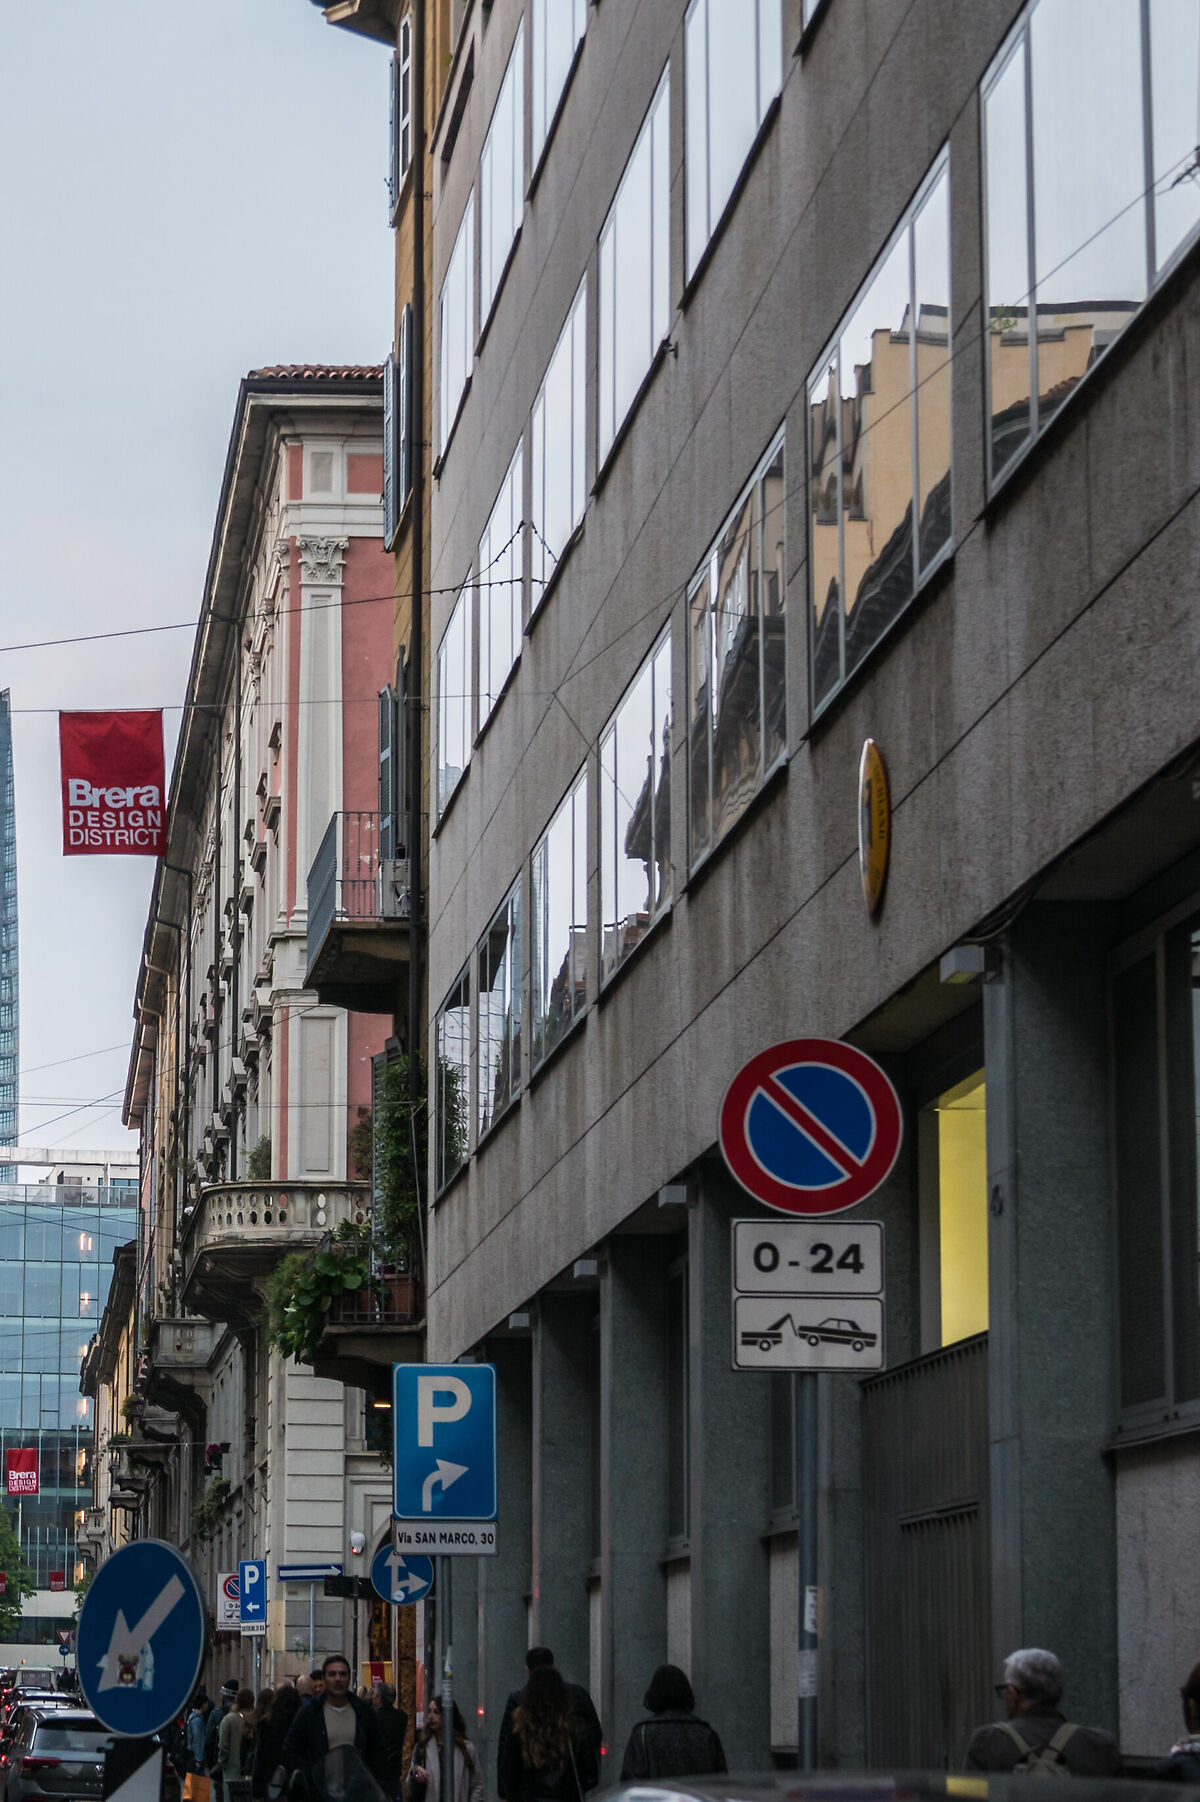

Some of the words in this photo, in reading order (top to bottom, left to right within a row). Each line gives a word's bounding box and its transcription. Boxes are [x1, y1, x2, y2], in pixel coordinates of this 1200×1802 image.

[68, 778, 160, 808] Brera
[69, 810, 161, 828] DESIGN
[69, 828, 161, 846] DISTRICT
[417, 1376, 472, 1447] P
[8, 1470, 36, 1480] Brera
[398, 1531, 412, 1544] Via
[415, 1531, 436, 1544] SAN
[439, 1532, 478, 1545] MARCO,
[481, 1533, 494, 1545] 30
[245, 1565, 260, 1594] P
